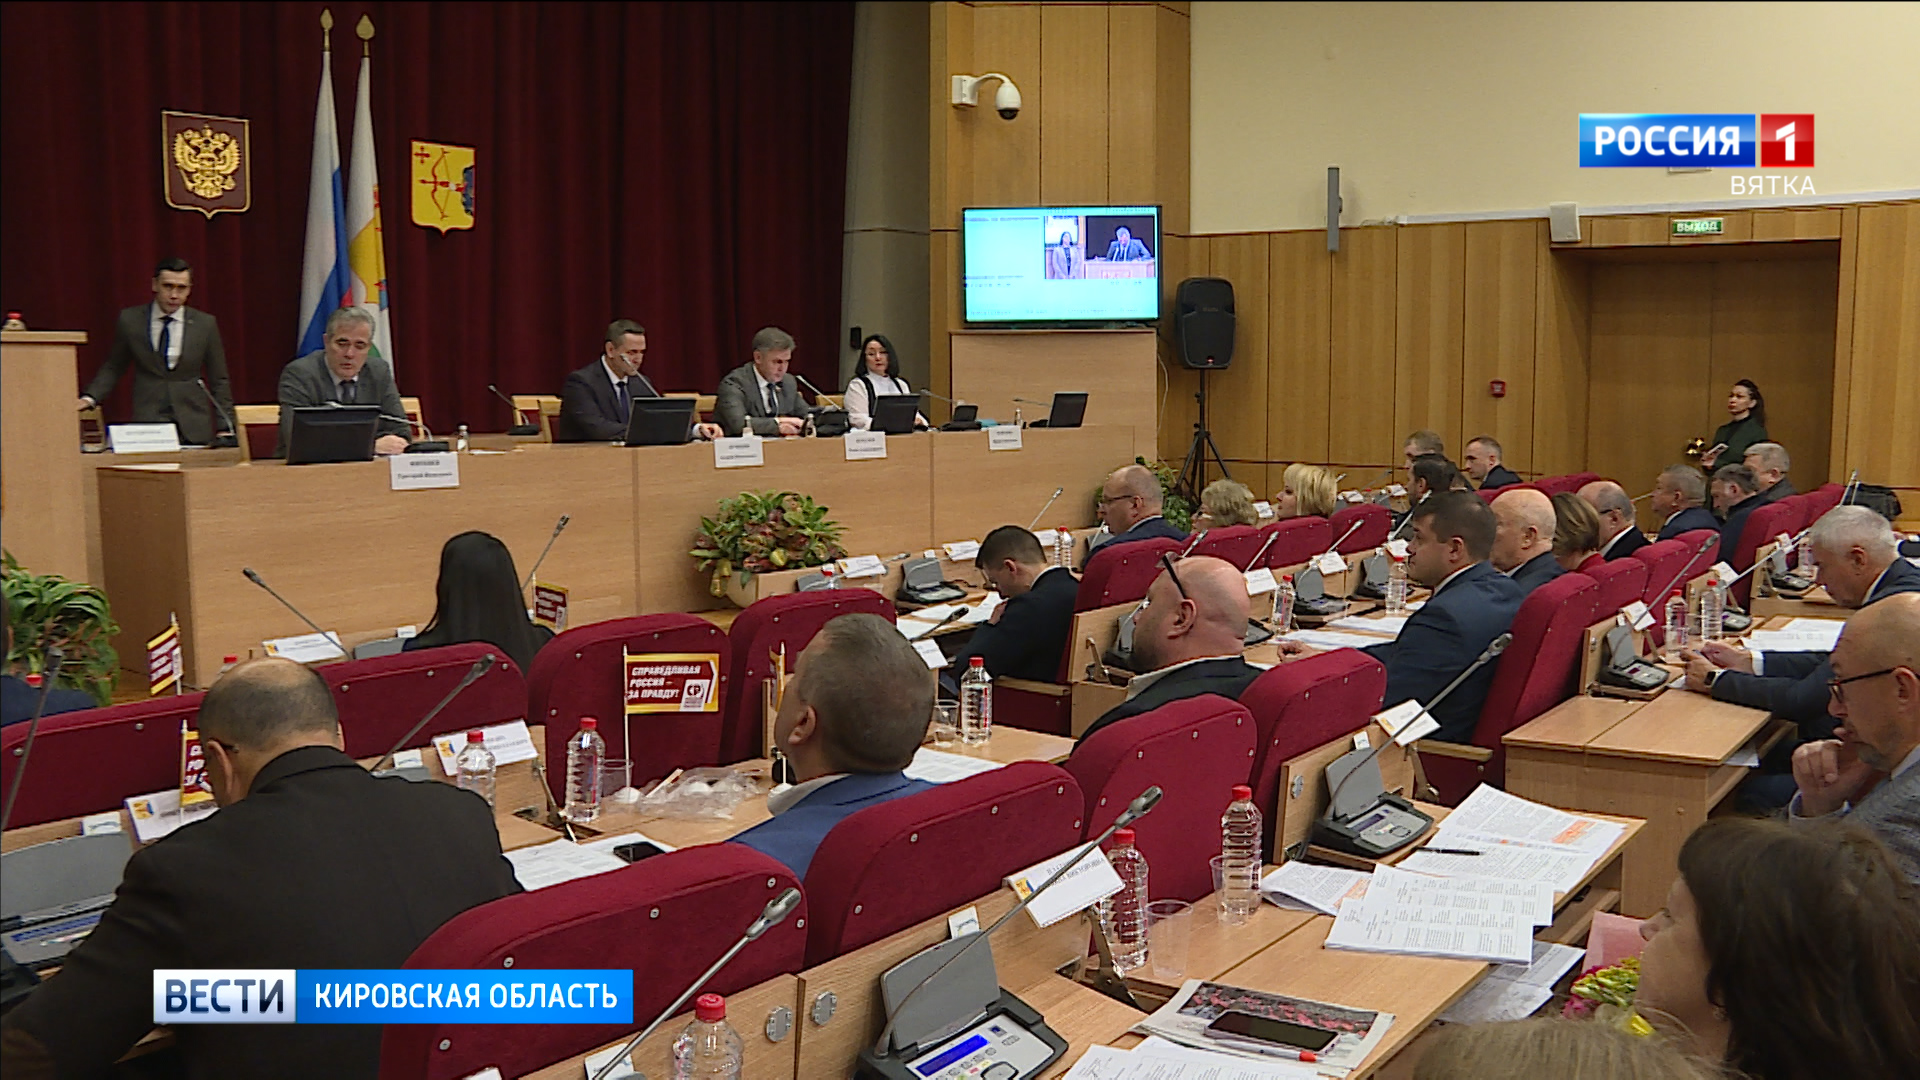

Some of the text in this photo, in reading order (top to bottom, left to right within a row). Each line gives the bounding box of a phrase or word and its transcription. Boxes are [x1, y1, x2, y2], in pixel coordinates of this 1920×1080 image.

[1676, 221, 1719, 232] ВЫХОД
[631, 665, 702, 677] СПРАВЕДЛИВАЯ
[629, 677, 665, 688] РОССИЯ
[626, 689, 680, 700] ЗА ПРАВДУ!
